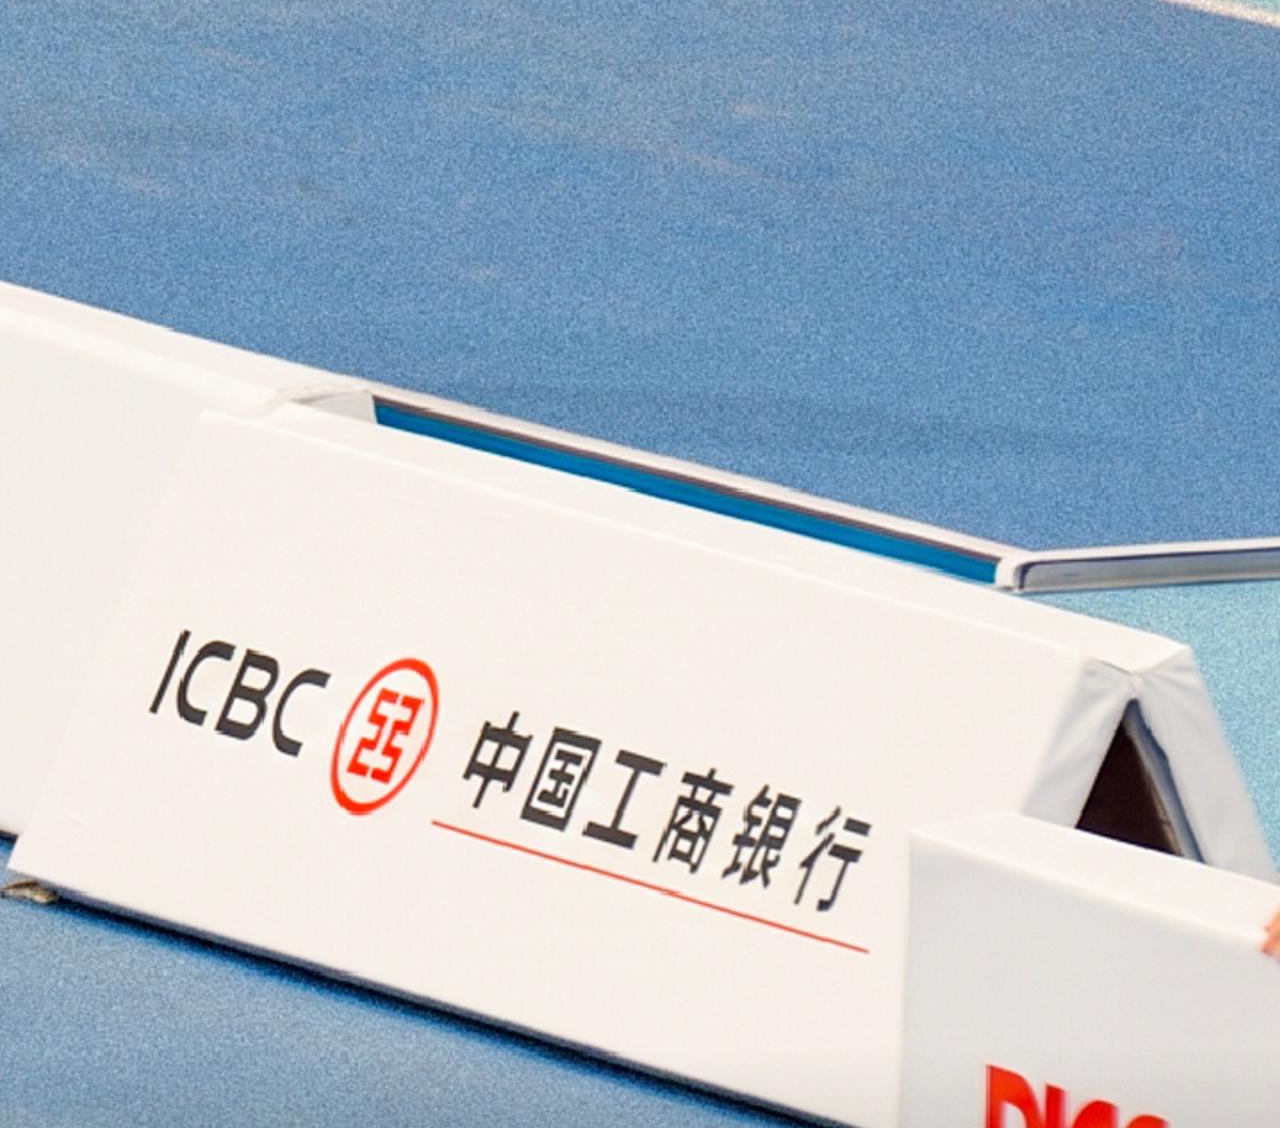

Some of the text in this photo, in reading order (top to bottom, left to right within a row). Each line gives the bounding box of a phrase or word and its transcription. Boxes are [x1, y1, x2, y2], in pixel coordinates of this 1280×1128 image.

[149, 629, 331, 757] ICBC
[462, 710, 872, 913] 中国工商银行
